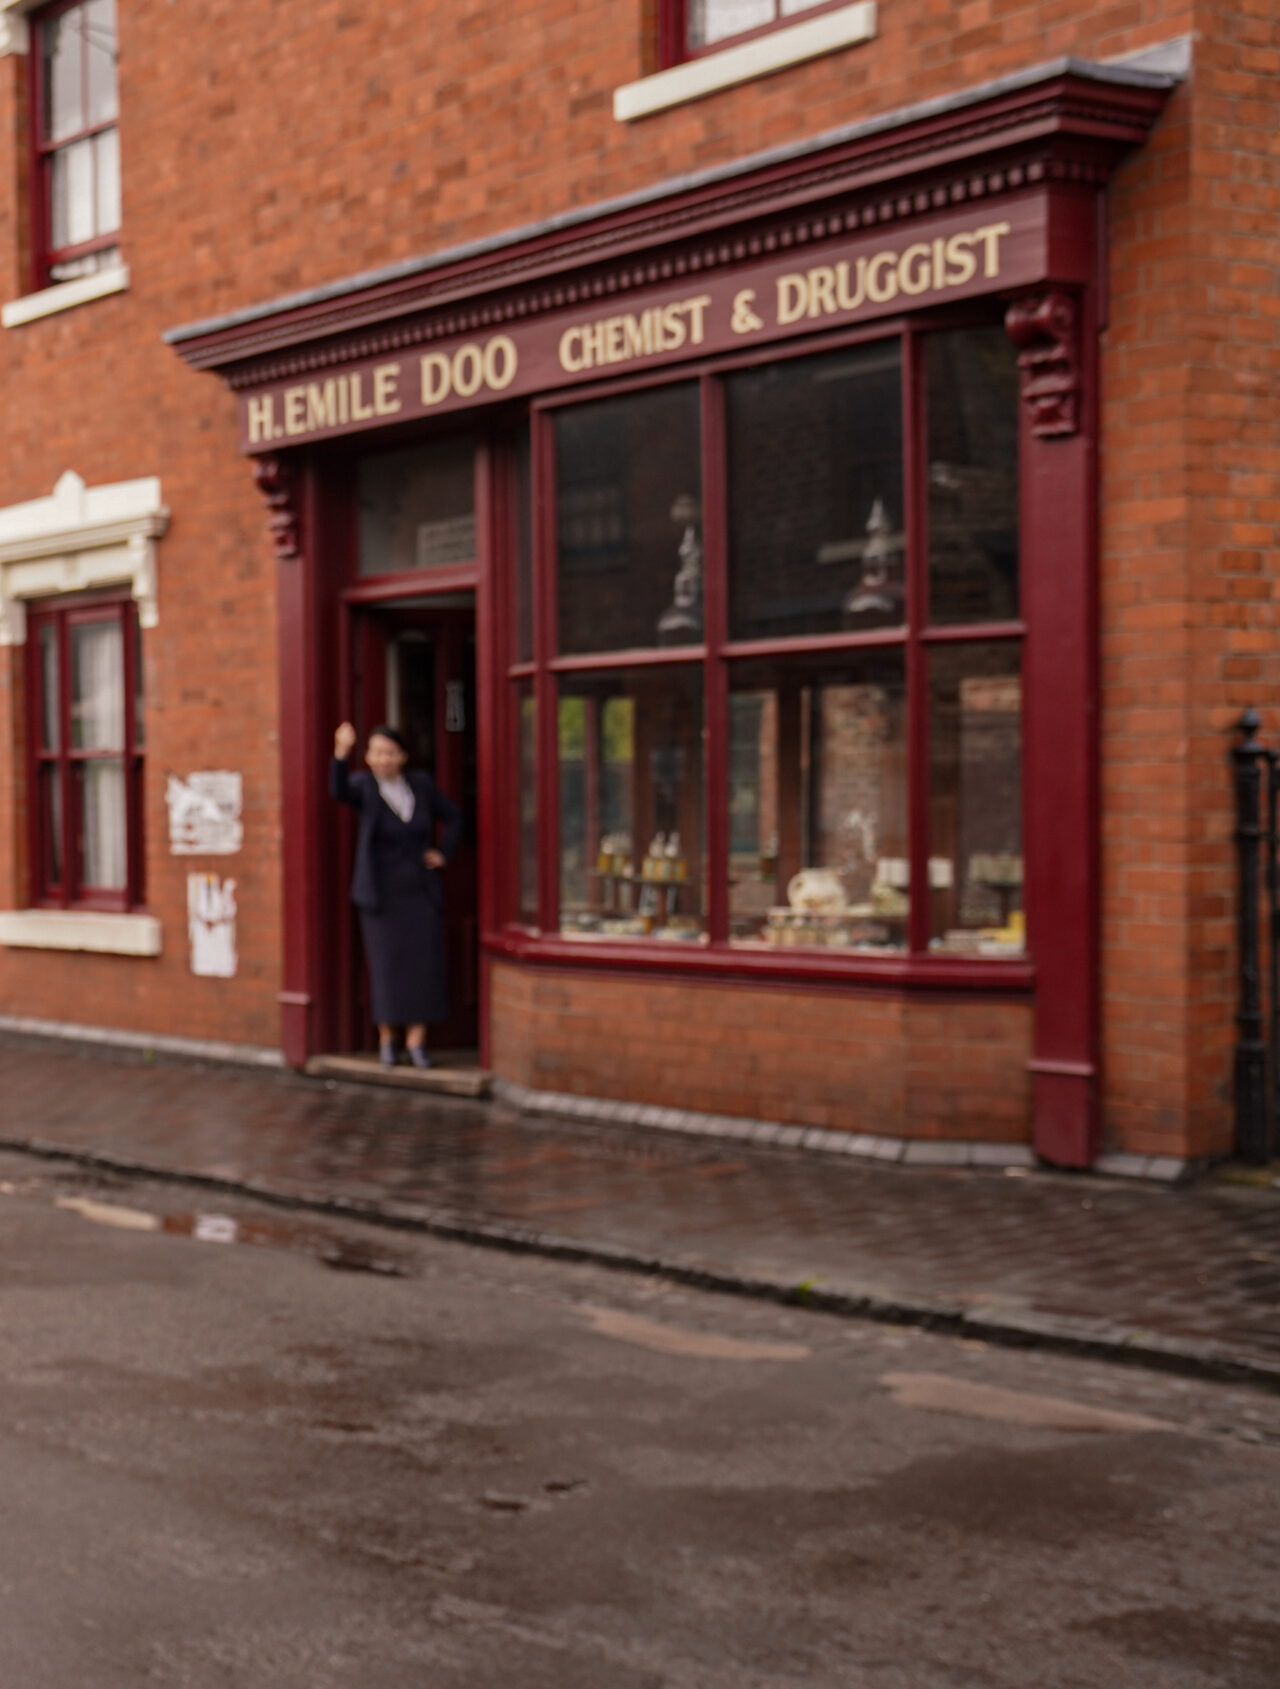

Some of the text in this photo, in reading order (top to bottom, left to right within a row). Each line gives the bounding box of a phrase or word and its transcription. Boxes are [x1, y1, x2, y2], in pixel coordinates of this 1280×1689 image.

[421, 335, 518, 405] DOO
[559, 295, 712, 372] CHEMIST
[730, 289, 764, 333] &
[776, 221, 1011, 324] DRUGGIST
